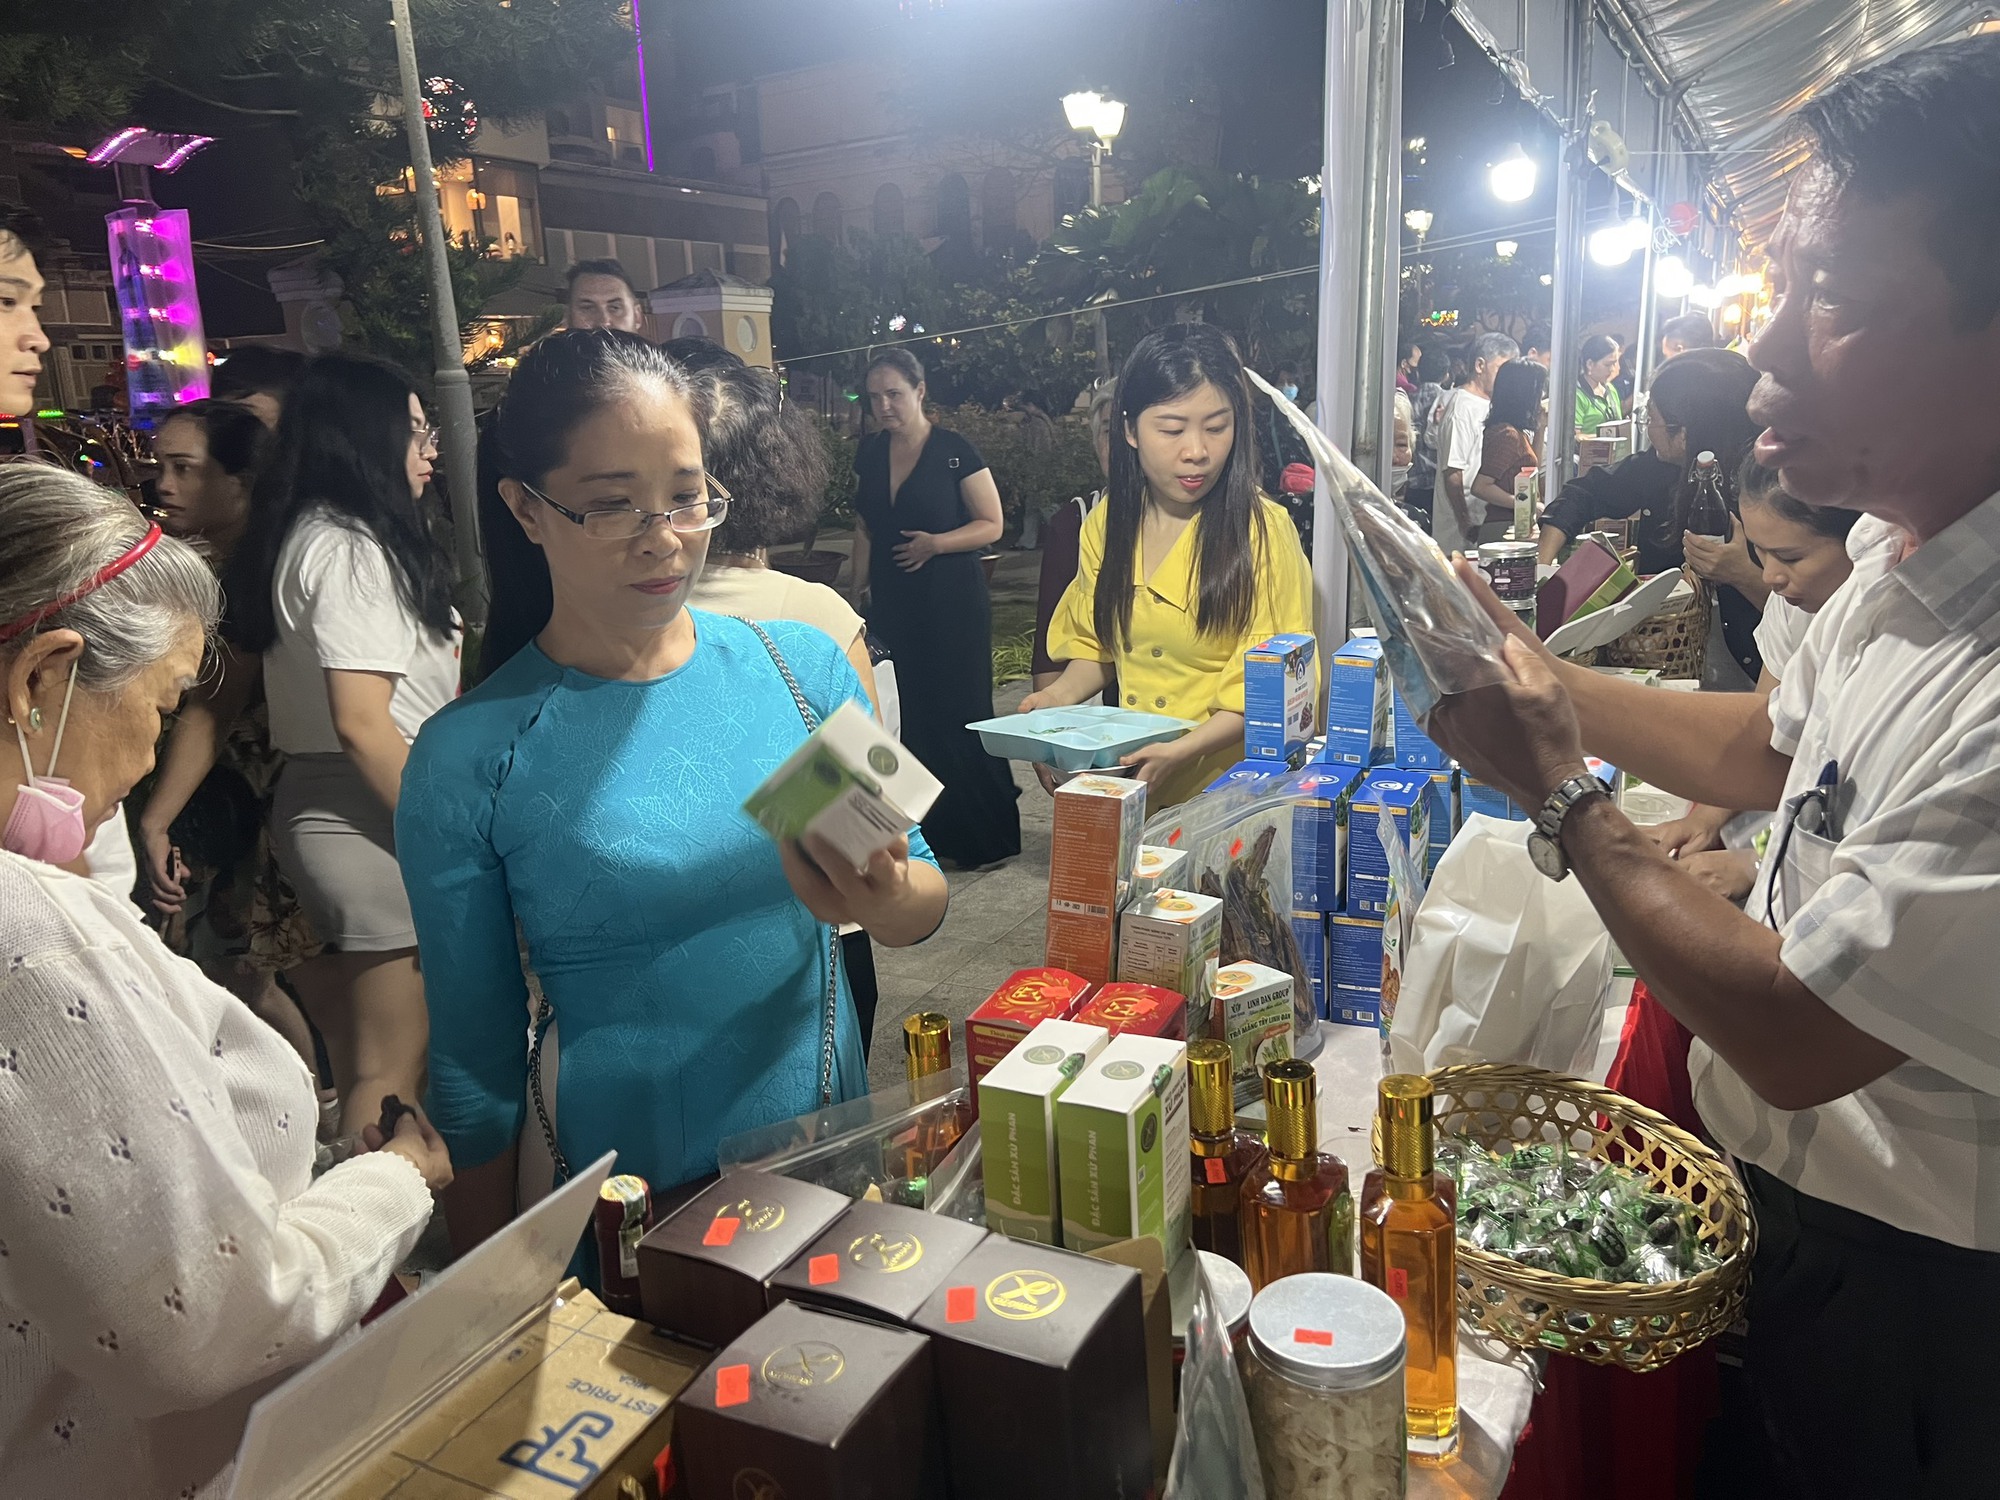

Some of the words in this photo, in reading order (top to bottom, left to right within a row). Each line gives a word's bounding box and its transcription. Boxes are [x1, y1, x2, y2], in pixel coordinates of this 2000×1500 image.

[1247, 997, 1260, 1009] LINH
[1260, 994, 1271, 1006] DAN
[1272, 988, 1289, 1000] GROUP
[1008, 1112, 1017, 1141] PHAN
[1088, 1130, 1097, 1160] PHAN
[566, 1377, 622, 1404] PRICE
